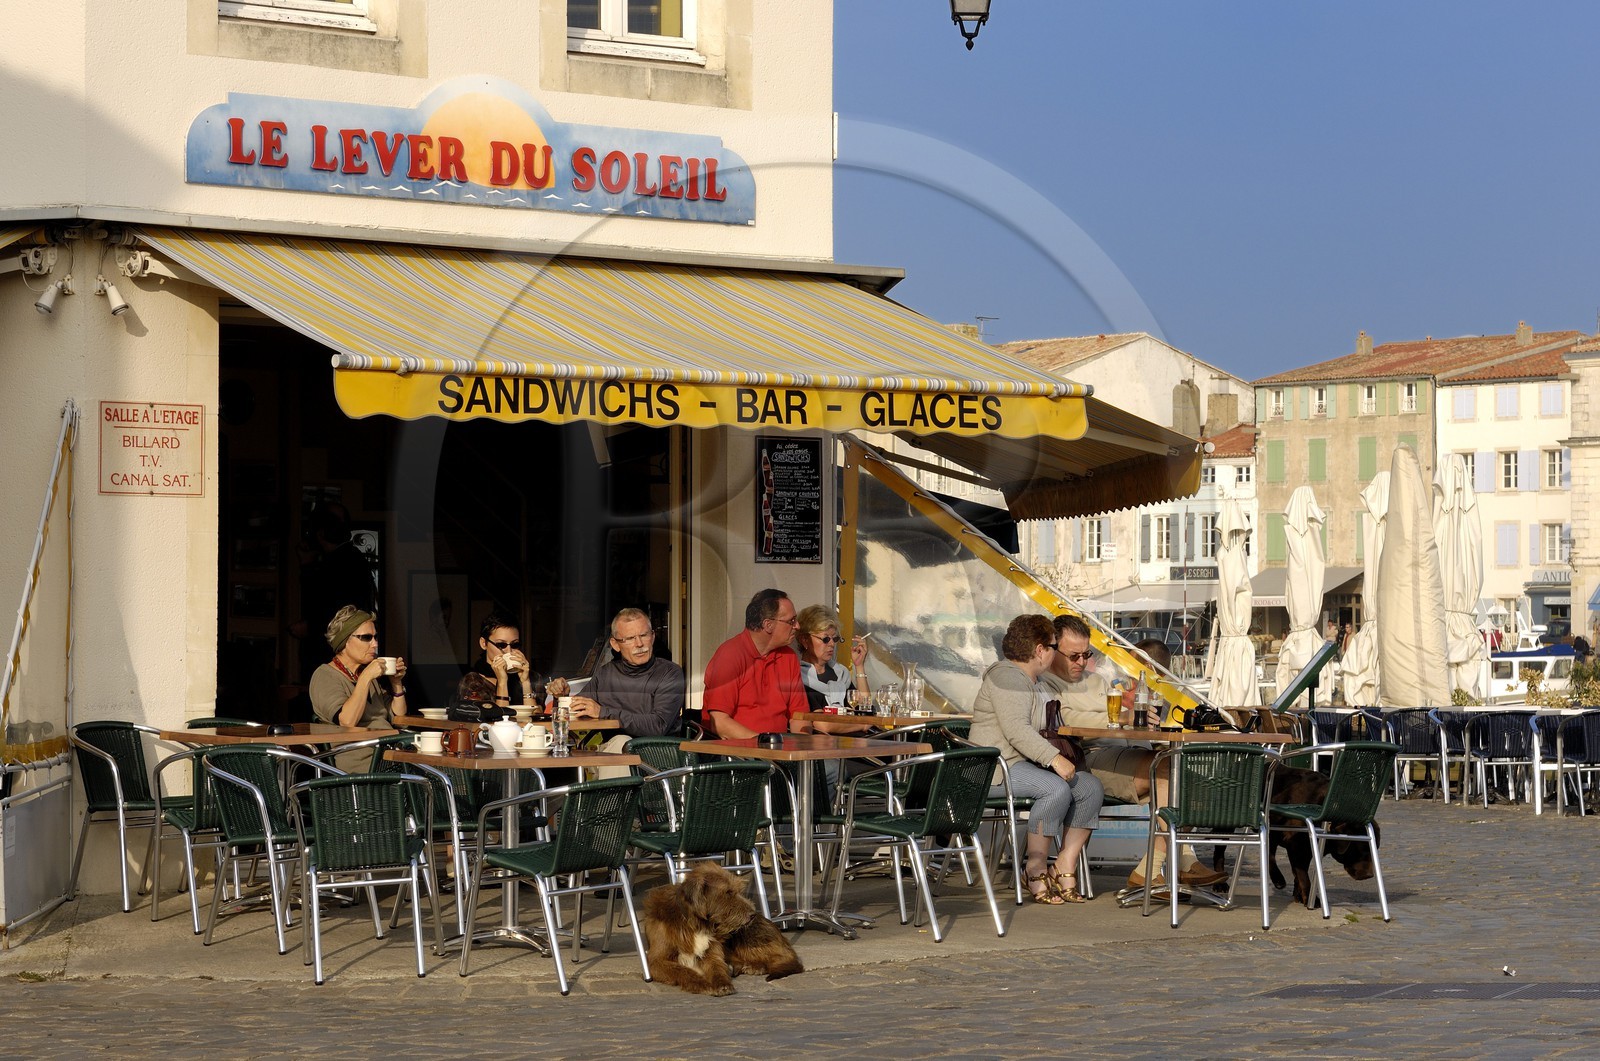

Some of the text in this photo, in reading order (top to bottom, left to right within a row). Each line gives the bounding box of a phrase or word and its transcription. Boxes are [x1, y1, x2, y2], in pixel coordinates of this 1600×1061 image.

[228, 117, 727, 202] LE LEVER DU SOLEIL
[438, 374, 681, 421] SANDWICHS
[736, 388, 808, 425] BAR
[860, 390, 1003, 431] GLACES
[104, 407, 139, 423] SALLE
[153, 410, 199, 425] L'ETAGE
[122, 435, 181, 449] BILLARD
[139, 455, 162, 468] T.V.
[111, 473, 192, 488] CANAL SAT.
